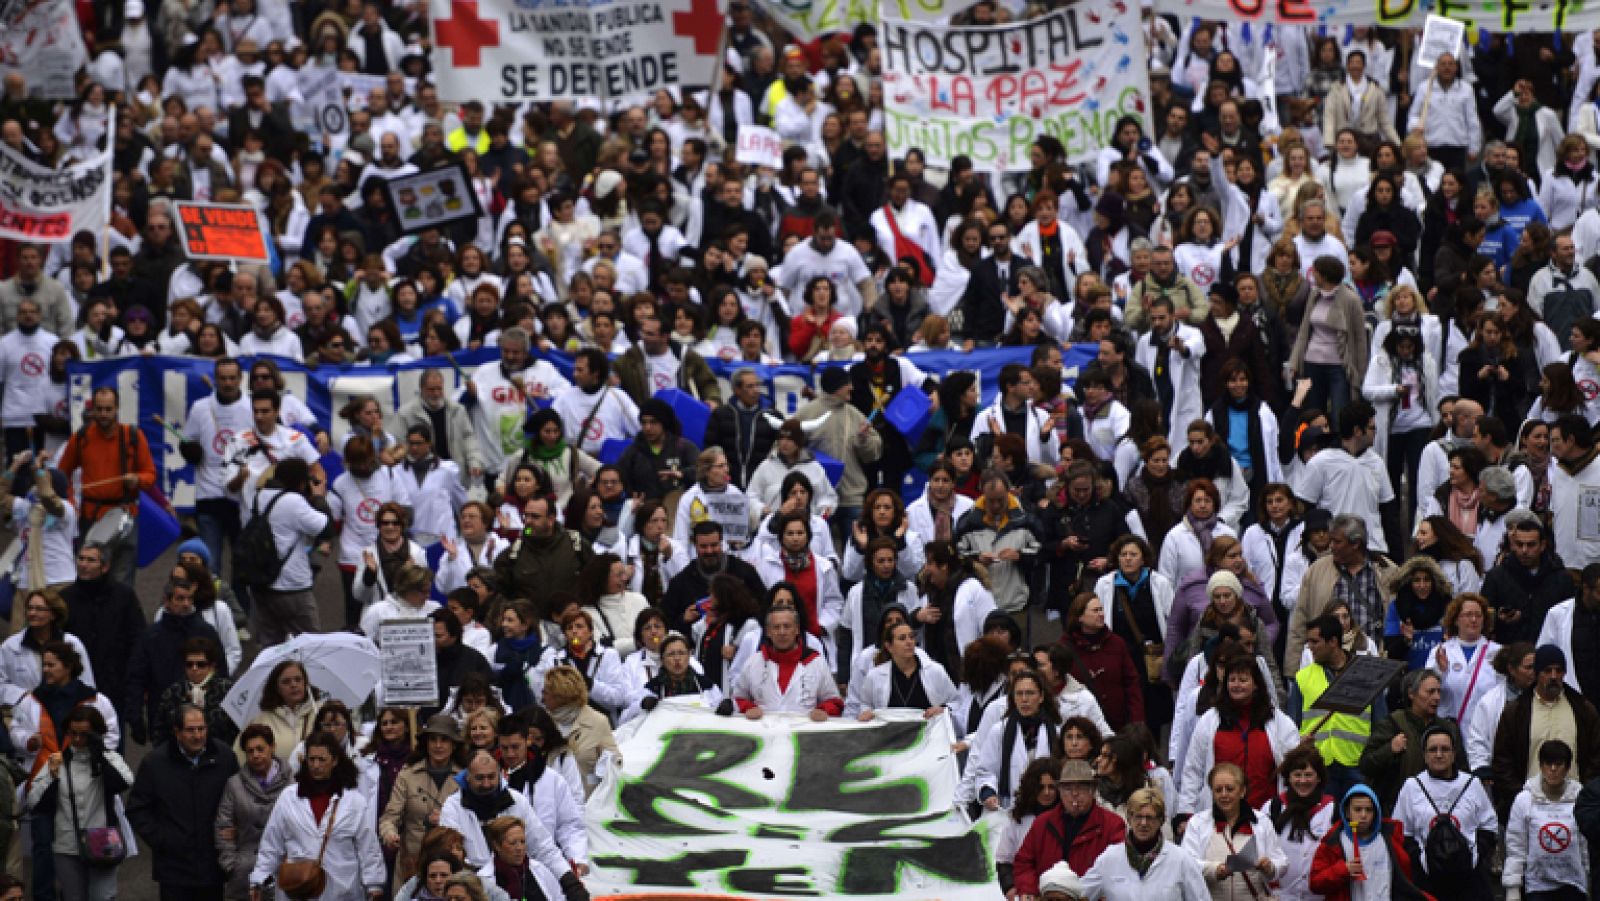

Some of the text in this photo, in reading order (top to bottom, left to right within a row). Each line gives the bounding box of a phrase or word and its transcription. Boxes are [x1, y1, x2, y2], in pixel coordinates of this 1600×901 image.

[543, 36, 566, 57] NO
[568, 35, 587, 57] SE
[882, 8, 1104, 76] HOSPITAL
[501, 64, 538, 97] SE
[928, 58, 1087, 118] LA PAZ
[885, 107, 998, 162] JUNTOS
[180, 206, 259, 230] SE VENDE
